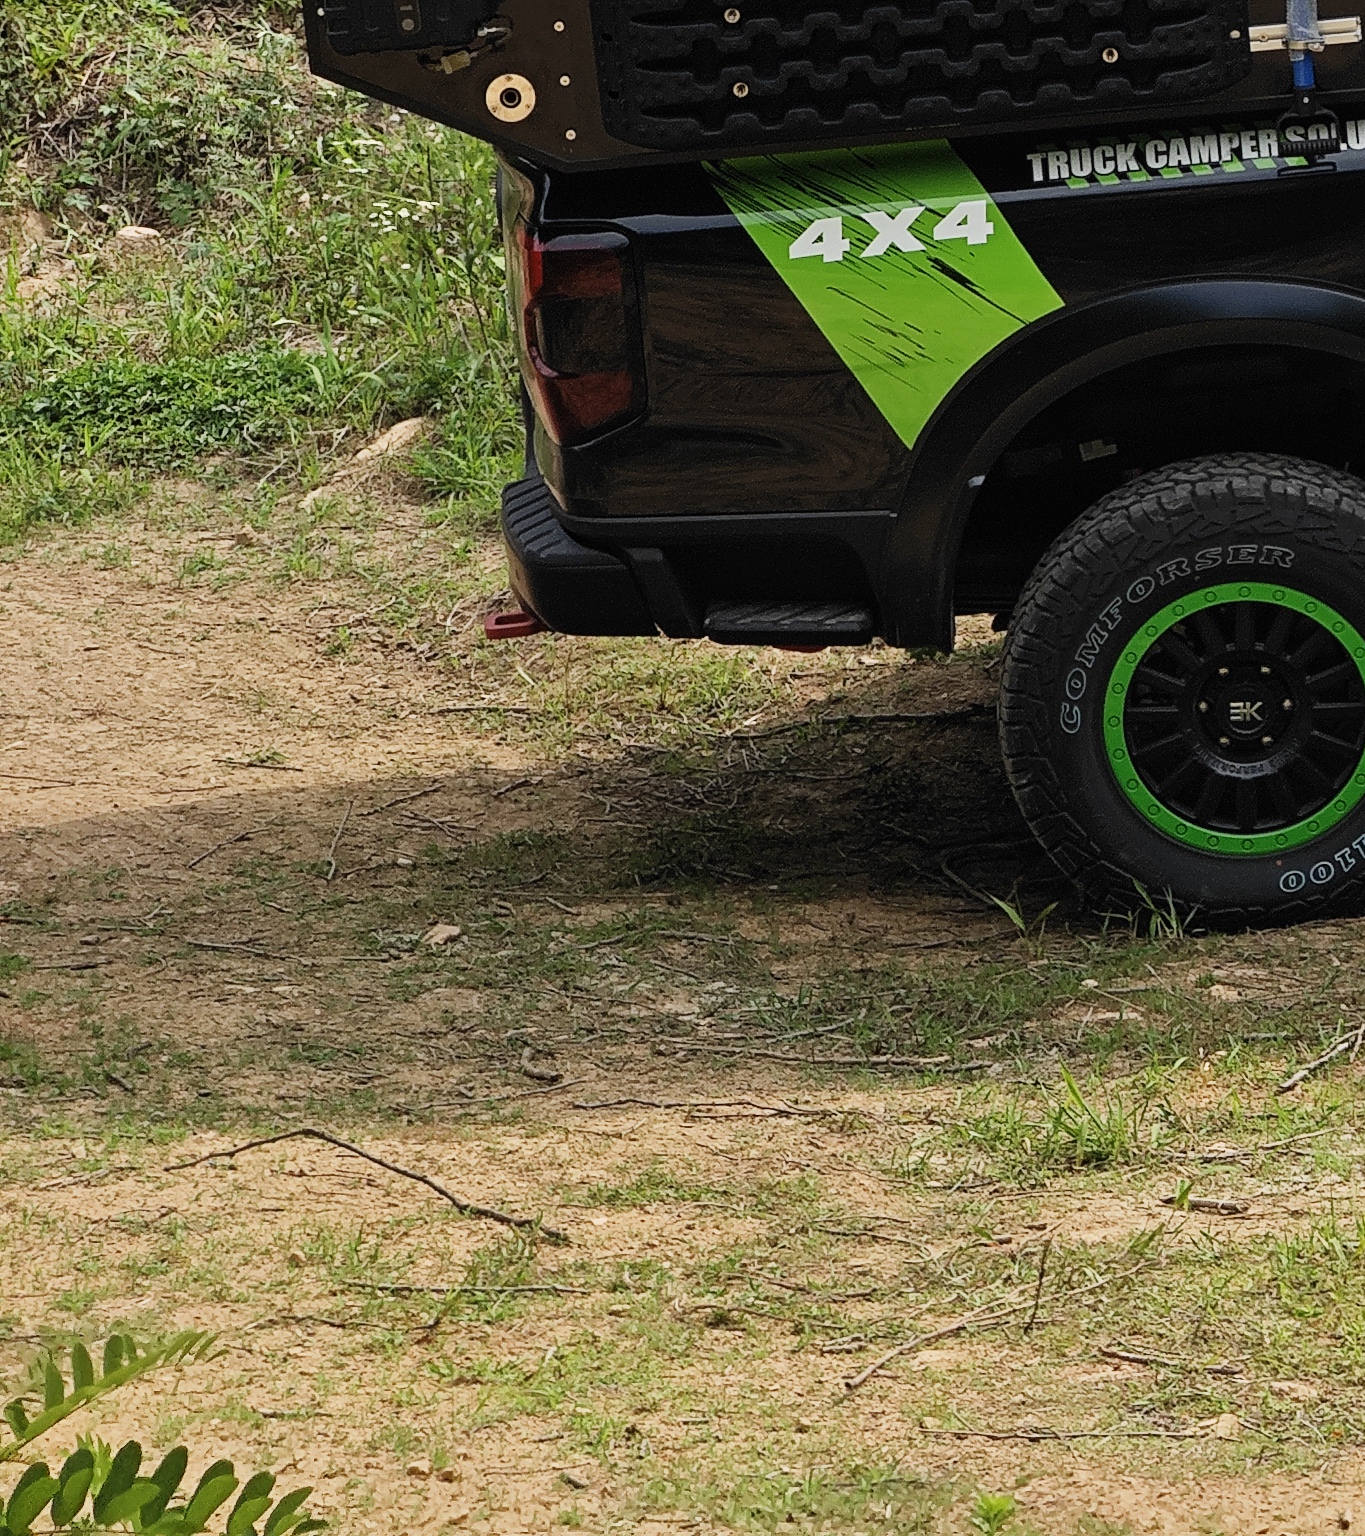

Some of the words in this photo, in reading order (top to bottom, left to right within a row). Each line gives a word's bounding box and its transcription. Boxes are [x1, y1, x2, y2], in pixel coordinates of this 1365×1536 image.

[1027, 143, 1138, 182] TRUCK
[1145, 129, 1280, 170] CAMPER
[1060, 544, 1297, 736] COMFORSER
